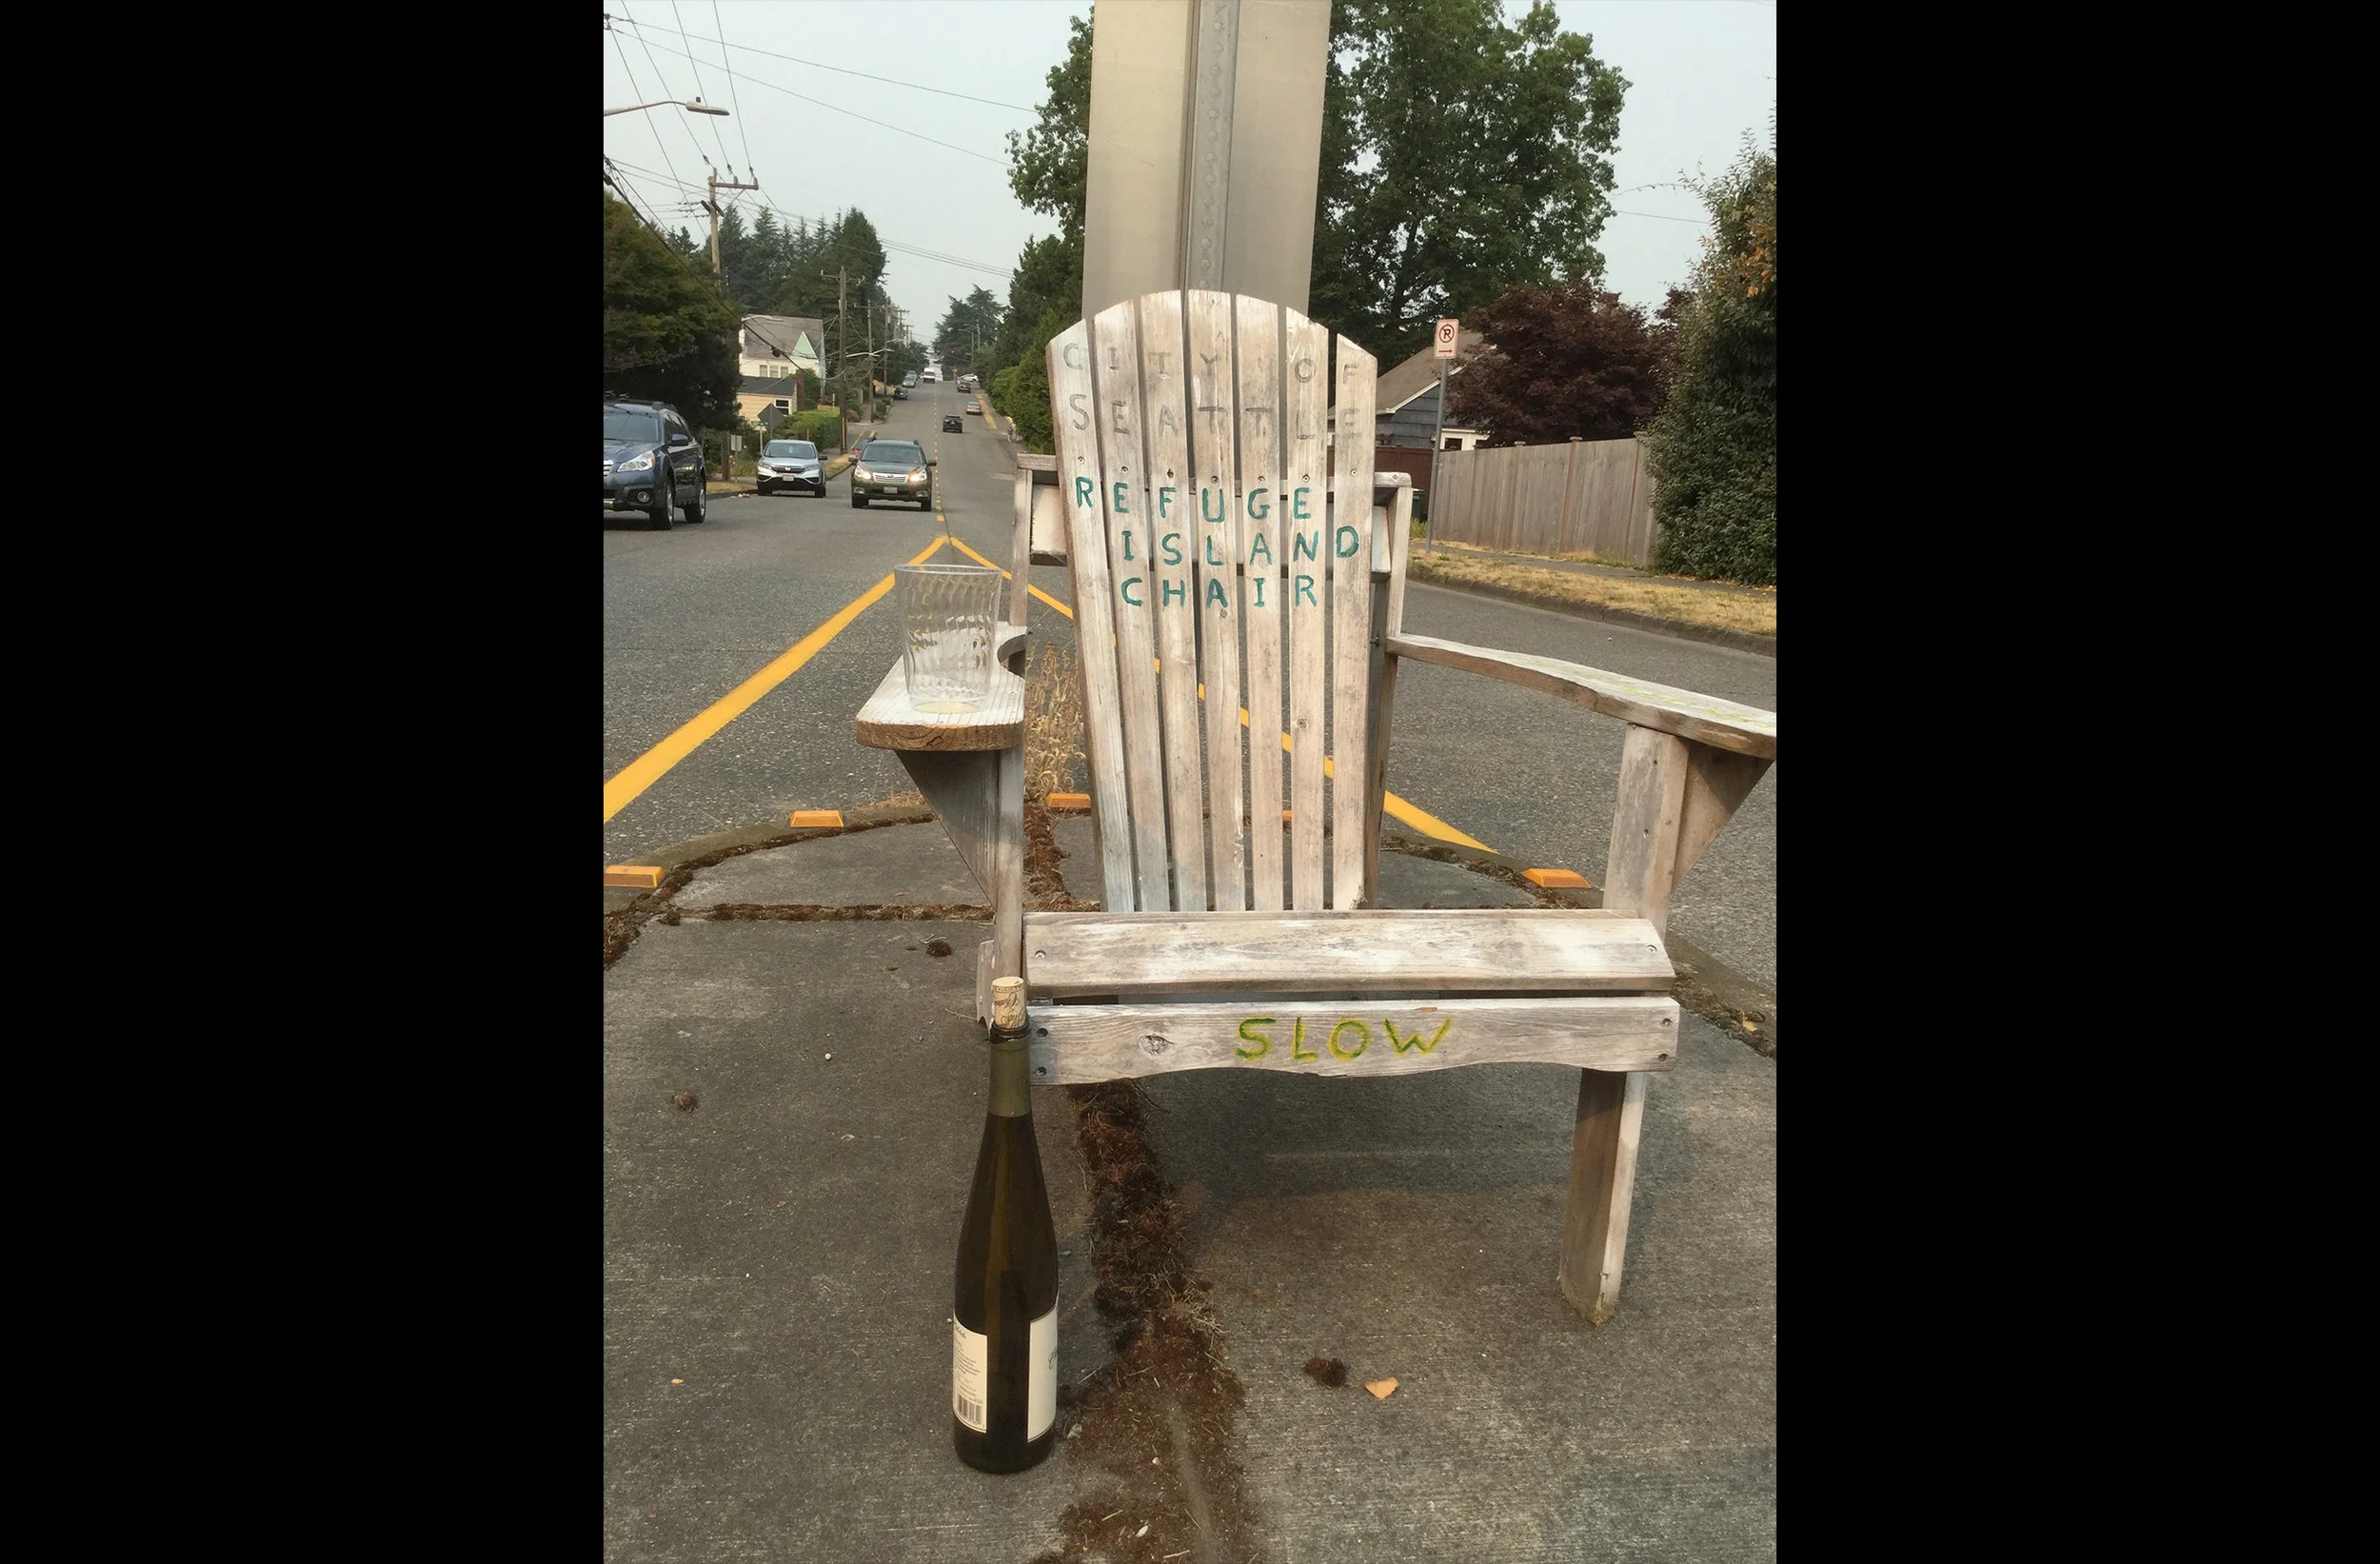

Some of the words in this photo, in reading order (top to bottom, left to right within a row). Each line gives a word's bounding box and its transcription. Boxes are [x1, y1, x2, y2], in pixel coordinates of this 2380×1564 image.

[1063, 343, 1219, 379] CITY
[1295, 359, 1359, 384] OF
[1069, 394, 1364, 441] SEATTLE
[1076, 477, 1311, 523] REFUGE
[1122, 525, 1359, 565] ISLAND
[1121, 575, 1318, 607] CHAIR
[1235, 1016, 1453, 1061] SLOW
